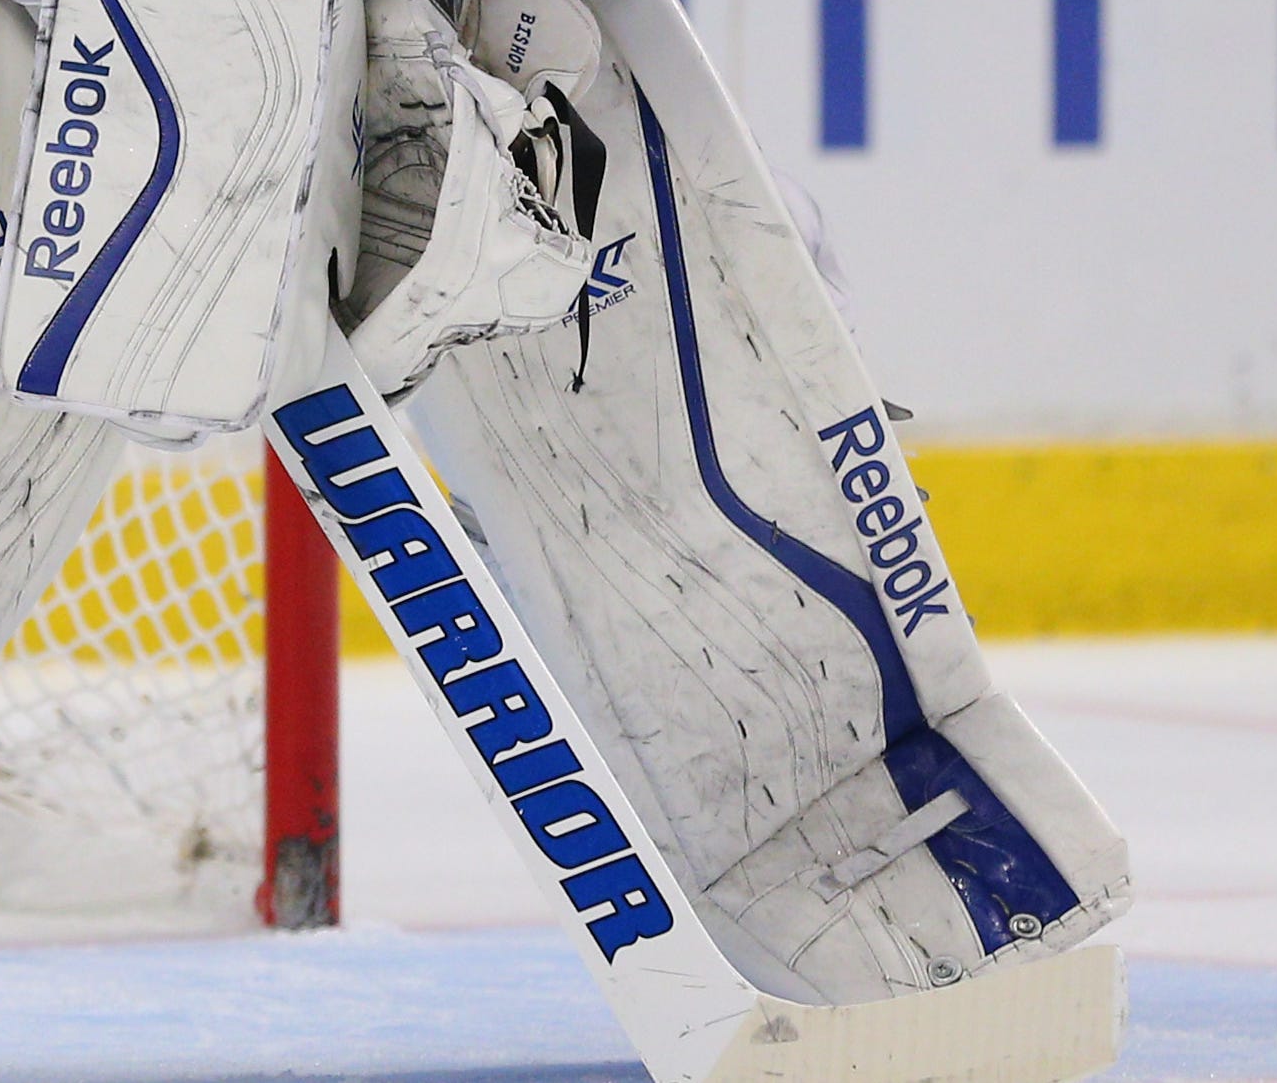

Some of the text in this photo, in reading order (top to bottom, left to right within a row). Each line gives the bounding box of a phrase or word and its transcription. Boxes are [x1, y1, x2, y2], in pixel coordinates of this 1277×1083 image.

[23, 34, 115, 282] Reebok
[505, 12, 536, 75] BISHOP
[561, 283, 637, 328] PEMIER
[817, 405, 950, 639] Reebok
[271, 383, 675, 966] WARRIOR
